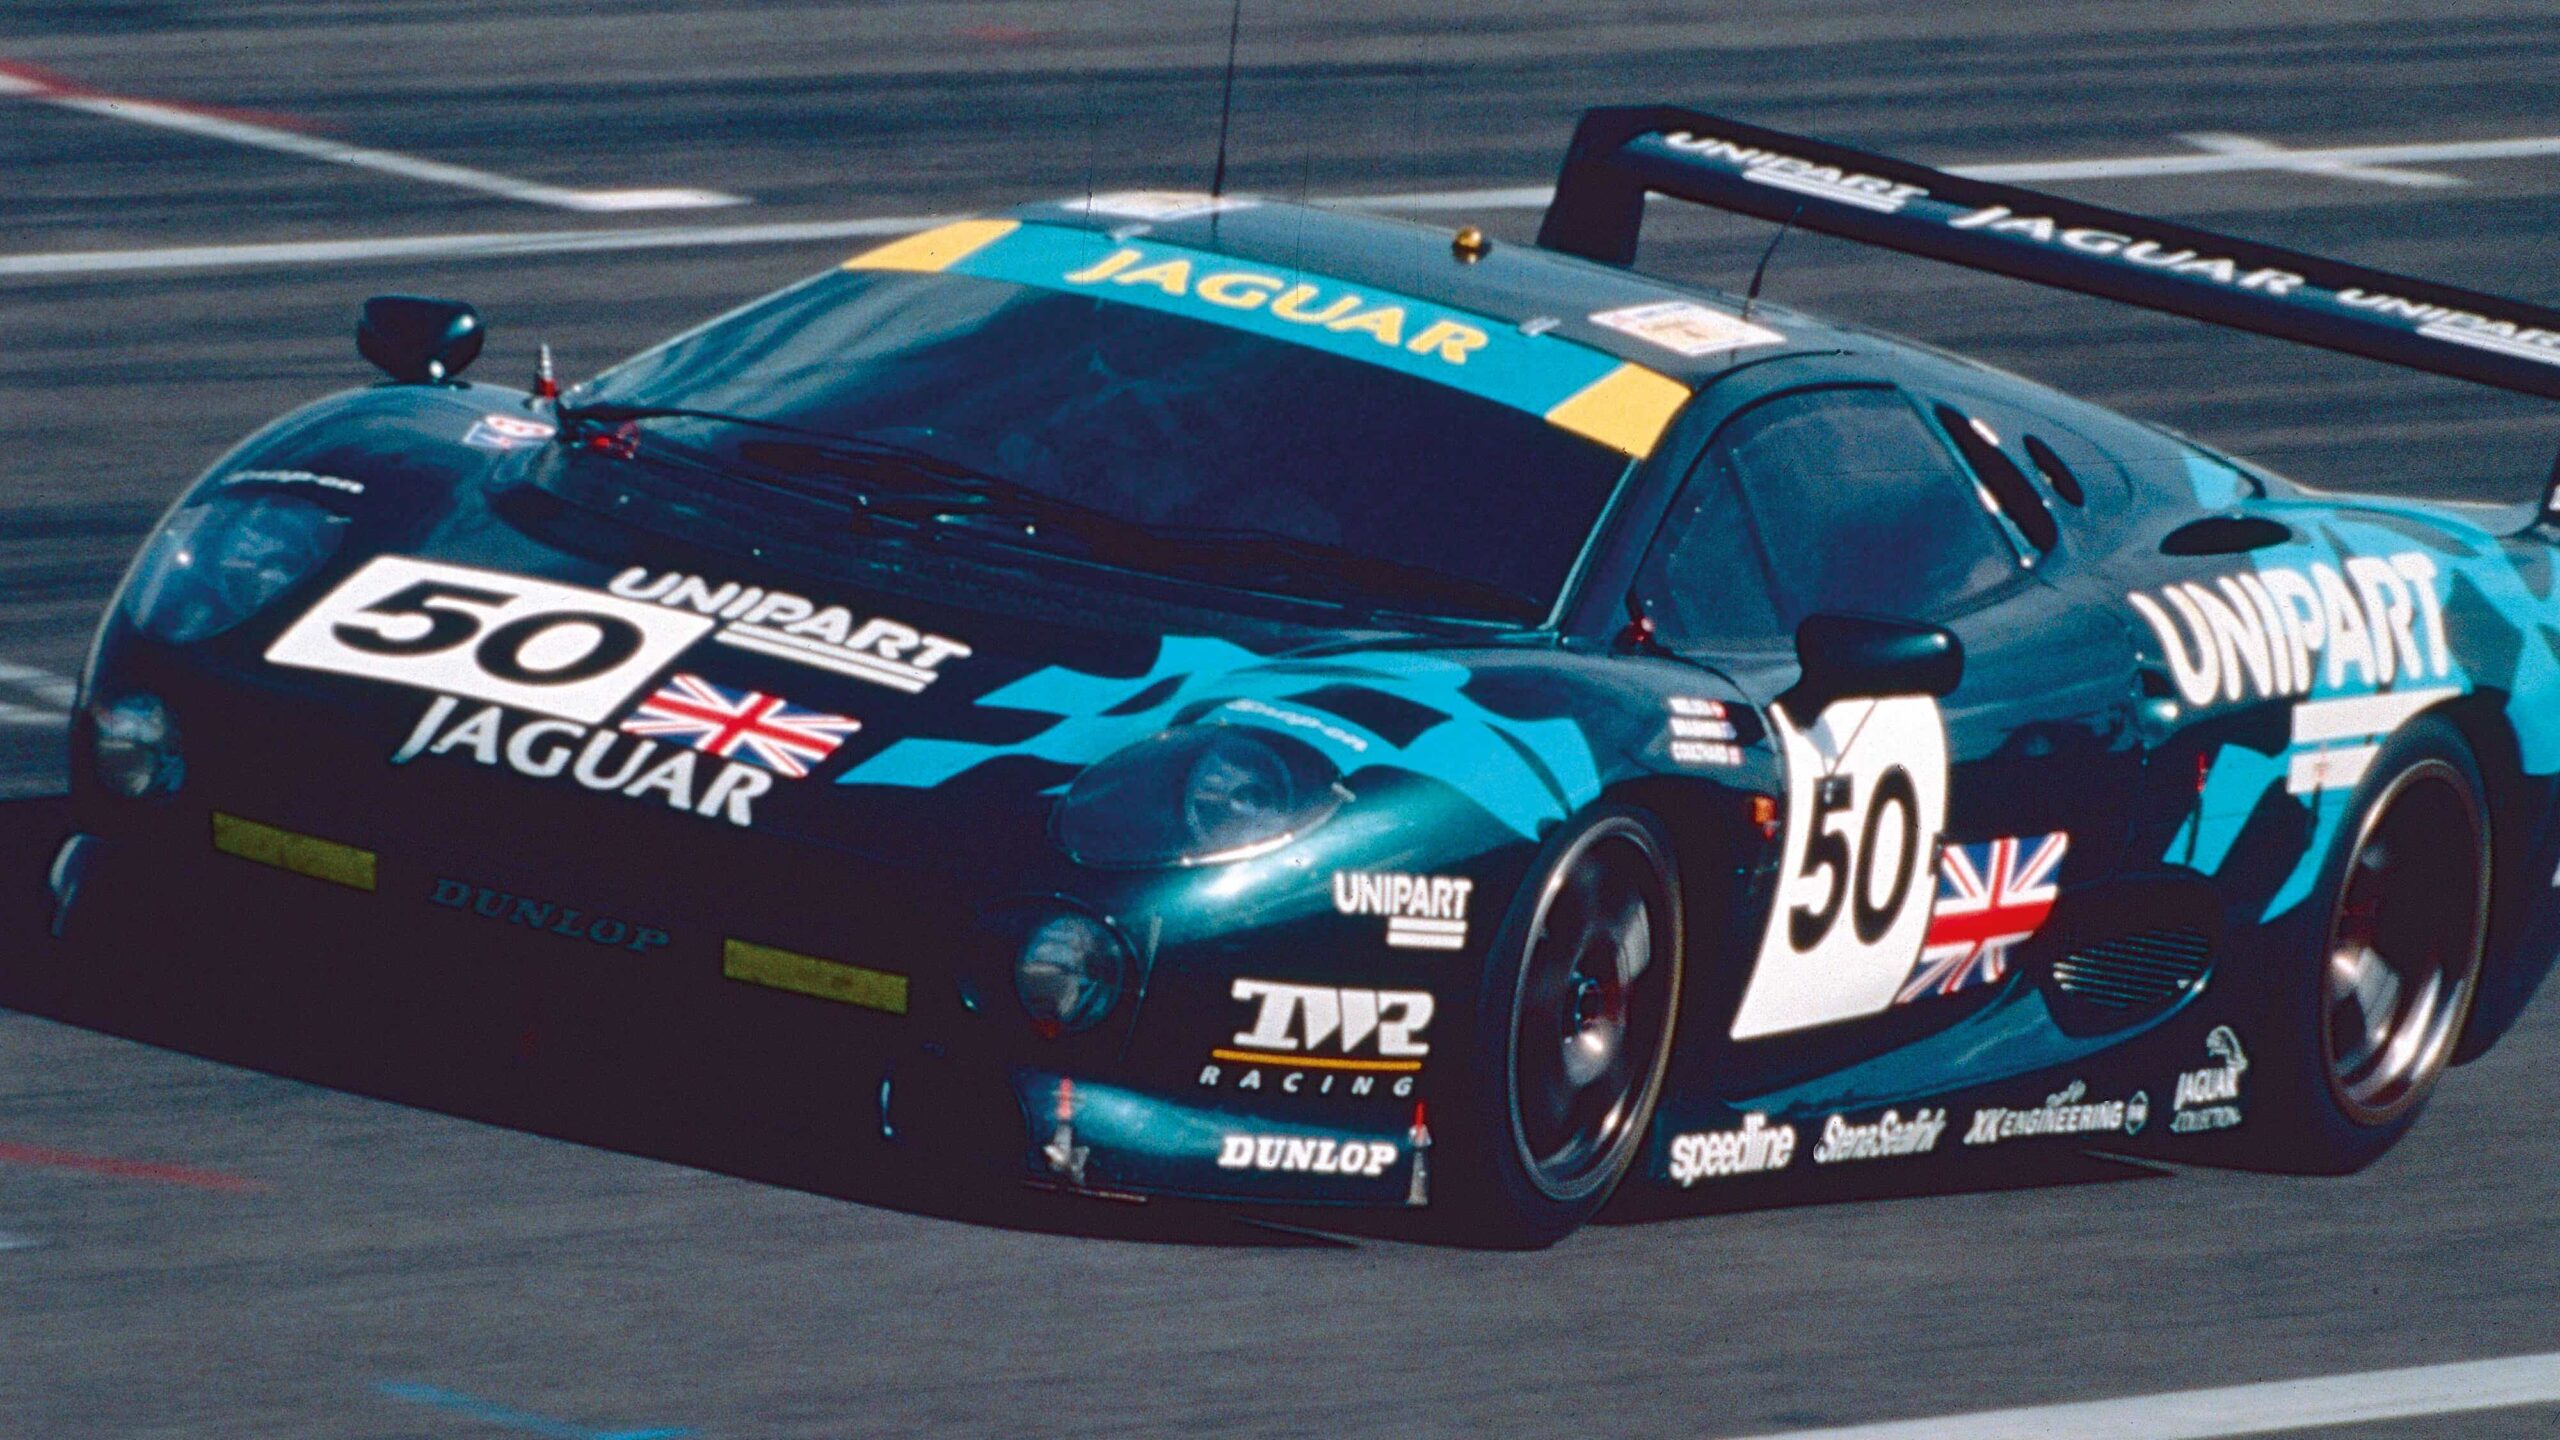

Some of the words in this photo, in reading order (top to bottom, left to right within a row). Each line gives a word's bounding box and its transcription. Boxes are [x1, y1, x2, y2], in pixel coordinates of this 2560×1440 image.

[1664, 131, 1930, 198] UNIPART
[1946, 205, 2305, 295] JAGUAR
[2335, 288, 2560, 352] UNIPAR
[1064, 249, 1488, 364] JAGUAR
[331, 579, 646, 687] 50
[606, 566, 973, 668] UNIPART
[2126, 551, 2448, 706] UNIPART
[391, 696, 773, 827] JAGUAR
[1332, 871, 1473, 918] UNIPART
[1787, 764, 1920, 953] 50
[431, 878, 670, 953] DUNLOP
[1231, 978, 1436, 1056] TWR
[1200, 1064, 1413, 1097] RACING
[2000, 1100, 2125, 1137] ENGINEERING
[2173, 1066, 2239, 1112] JAGUAR
[1217, 1134, 1397, 1177] DUNLOP
[1669, 1111, 1796, 1188] speedline
